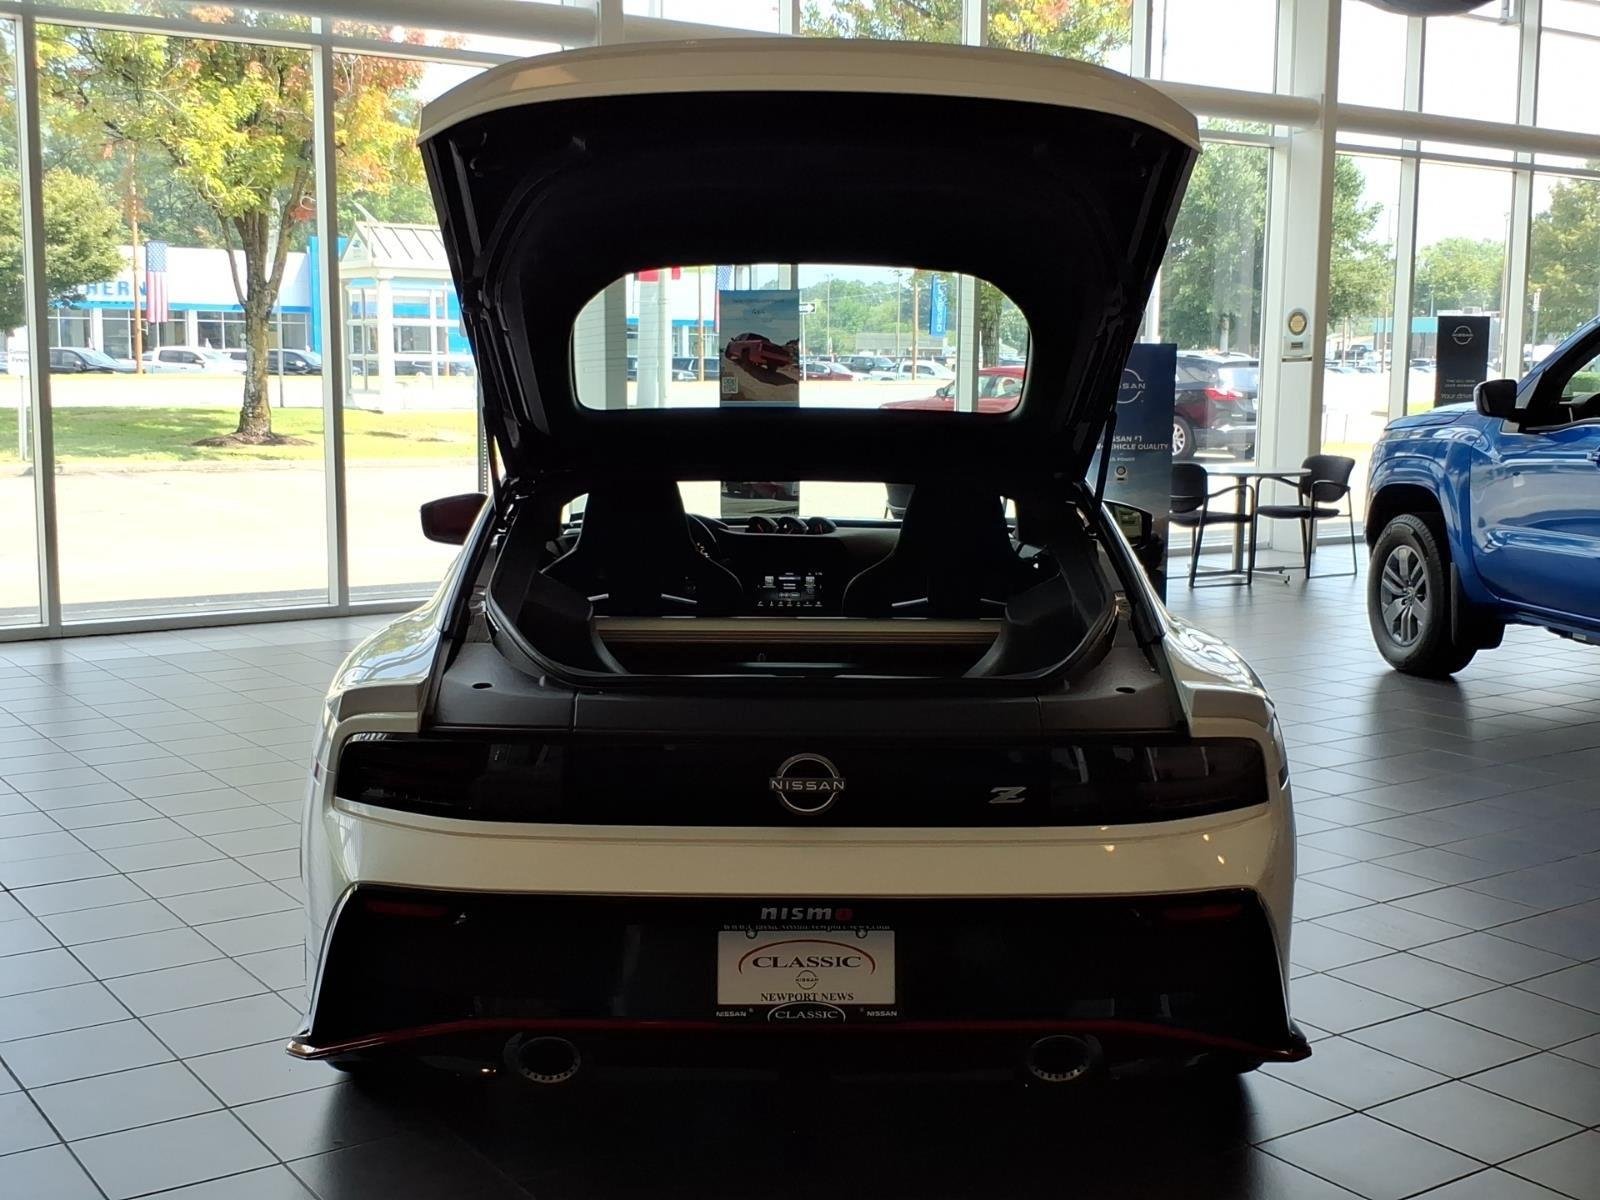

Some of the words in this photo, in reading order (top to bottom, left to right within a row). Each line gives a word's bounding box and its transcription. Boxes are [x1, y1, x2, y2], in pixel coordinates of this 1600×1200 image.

[771, 780, 845, 791] NISSAN
[988, 786, 1027, 804] Z
[761, 907, 853, 920] nismo
[752, 956, 861, 968] CLASSIC
[761, 992, 819, 1001] NEWPORT
[821, 992, 854, 1001] NEWS
[775, 1011, 839, 1019] CLASSIC
